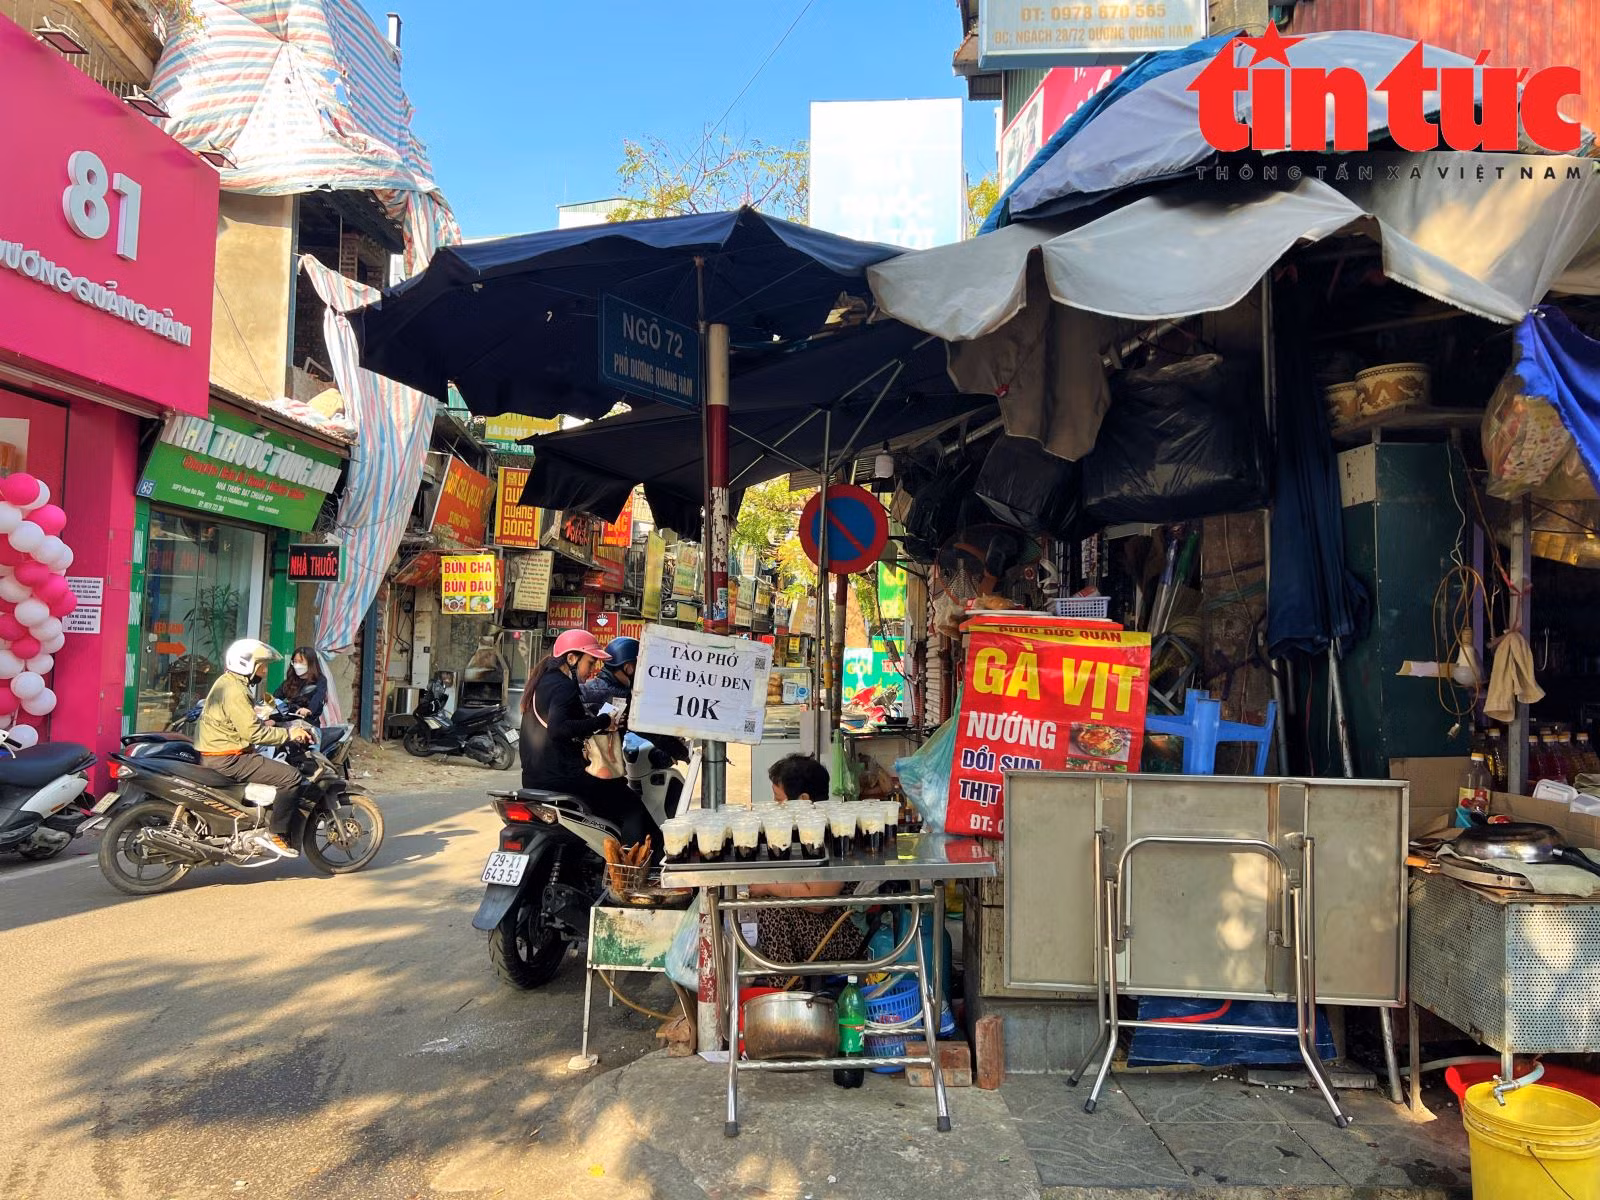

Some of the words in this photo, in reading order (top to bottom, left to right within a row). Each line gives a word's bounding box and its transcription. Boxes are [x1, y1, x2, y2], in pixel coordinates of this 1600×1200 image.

[1050, 6, 1092, 21] 0978
[63, 150, 141, 261] 81
[75, 276, 149, 327] QUẢNG
[148, 308, 191, 347] HÀM
[622, 312, 661, 351] NGÕ
[665, 329, 683, 358] 72
[613, 346, 629, 376] PHỐ
[208, 425, 275, 472] THUỐC
[140, 481, 155, 495] 85
[290, 552, 308, 577] NHÀ
[310, 551, 338, 577] THUỐC
[444, 559, 467, 574] BÚN
[444, 578, 467, 593] BÚN
[671, 643, 703, 662] TÀO
[707, 652, 739, 668] PHỚ
[648, 664, 681, 681] CHÈ
[686, 670, 718, 688] ĐẬU
[721, 676, 751, 692] ĐEN
[972, 641, 1041, 701] GÀ
[1062, 657, 1142, 721] VỊT
[674, 695, 721, 721] 10K
[966, 710, 1057, 750] NƯỚNG
[959, 779, 1001, 807] THỊT
[970, 814, 993, 832] ĐT:
